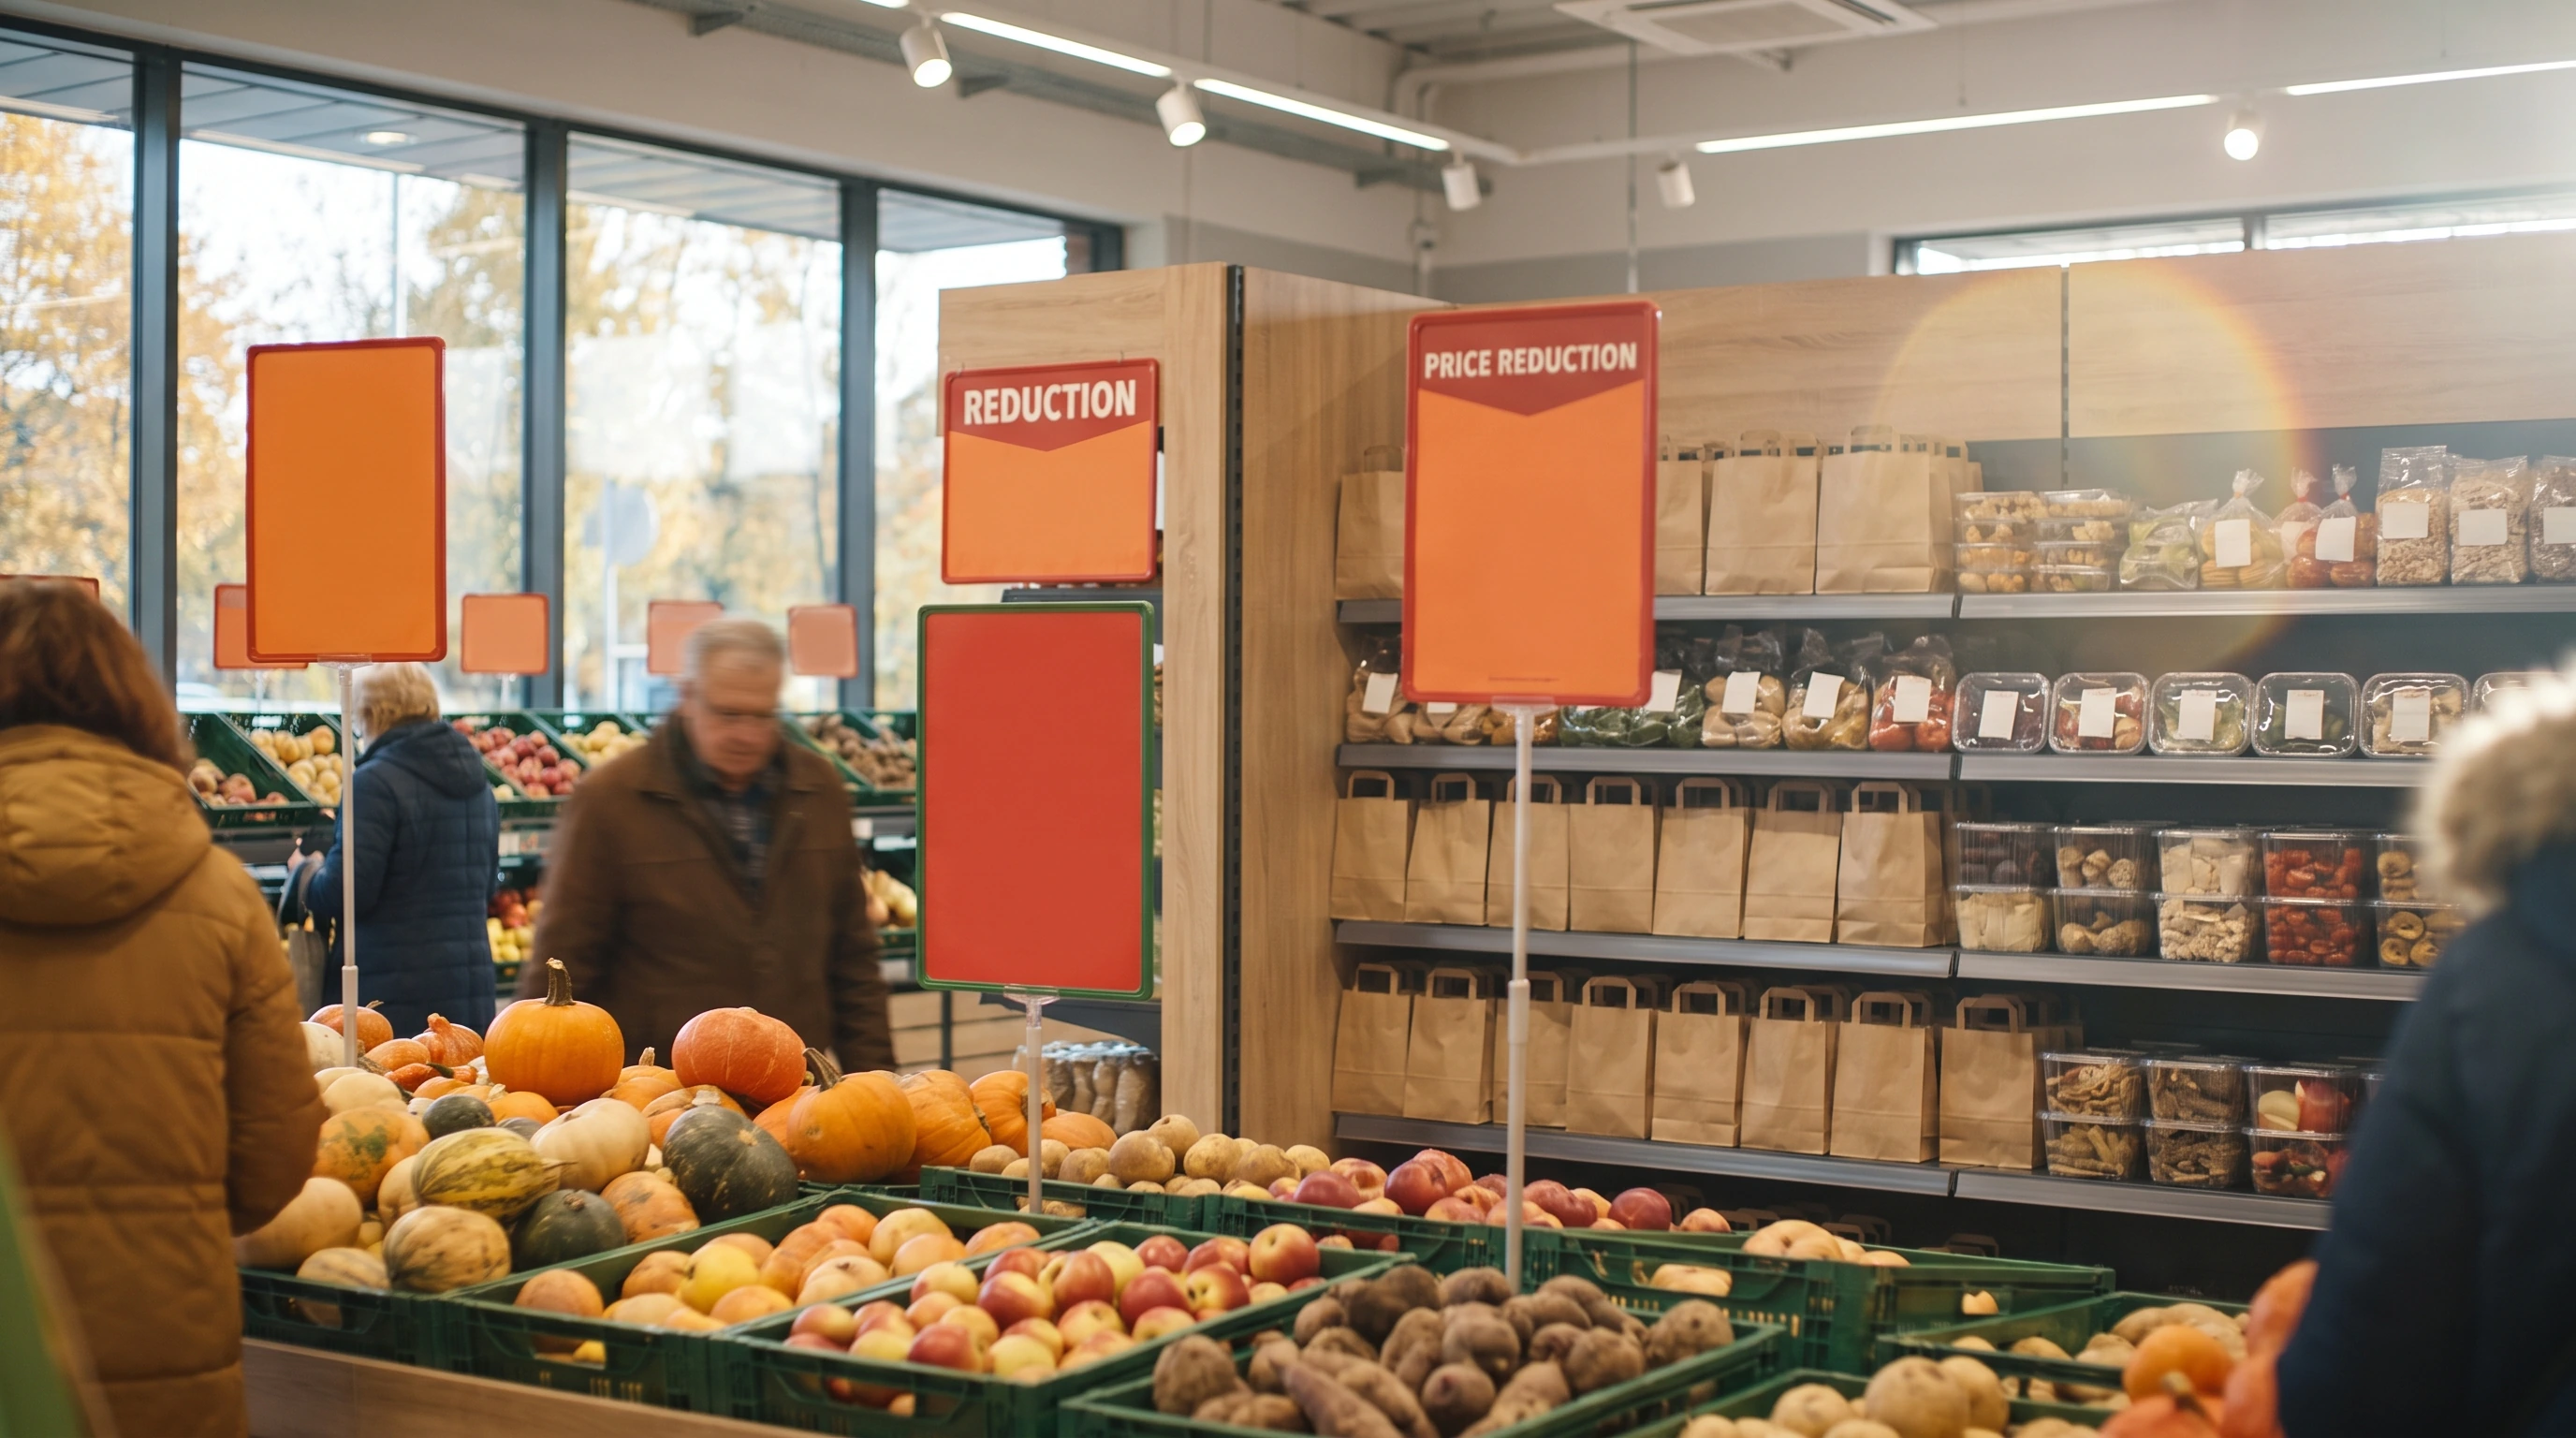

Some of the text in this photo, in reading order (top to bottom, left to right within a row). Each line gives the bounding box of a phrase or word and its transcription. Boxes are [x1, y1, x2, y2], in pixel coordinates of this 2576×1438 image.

[1424, 342, 1637, 379] PRICE REDUCTION
[963, 379, 1136, 426] REDUCTION
